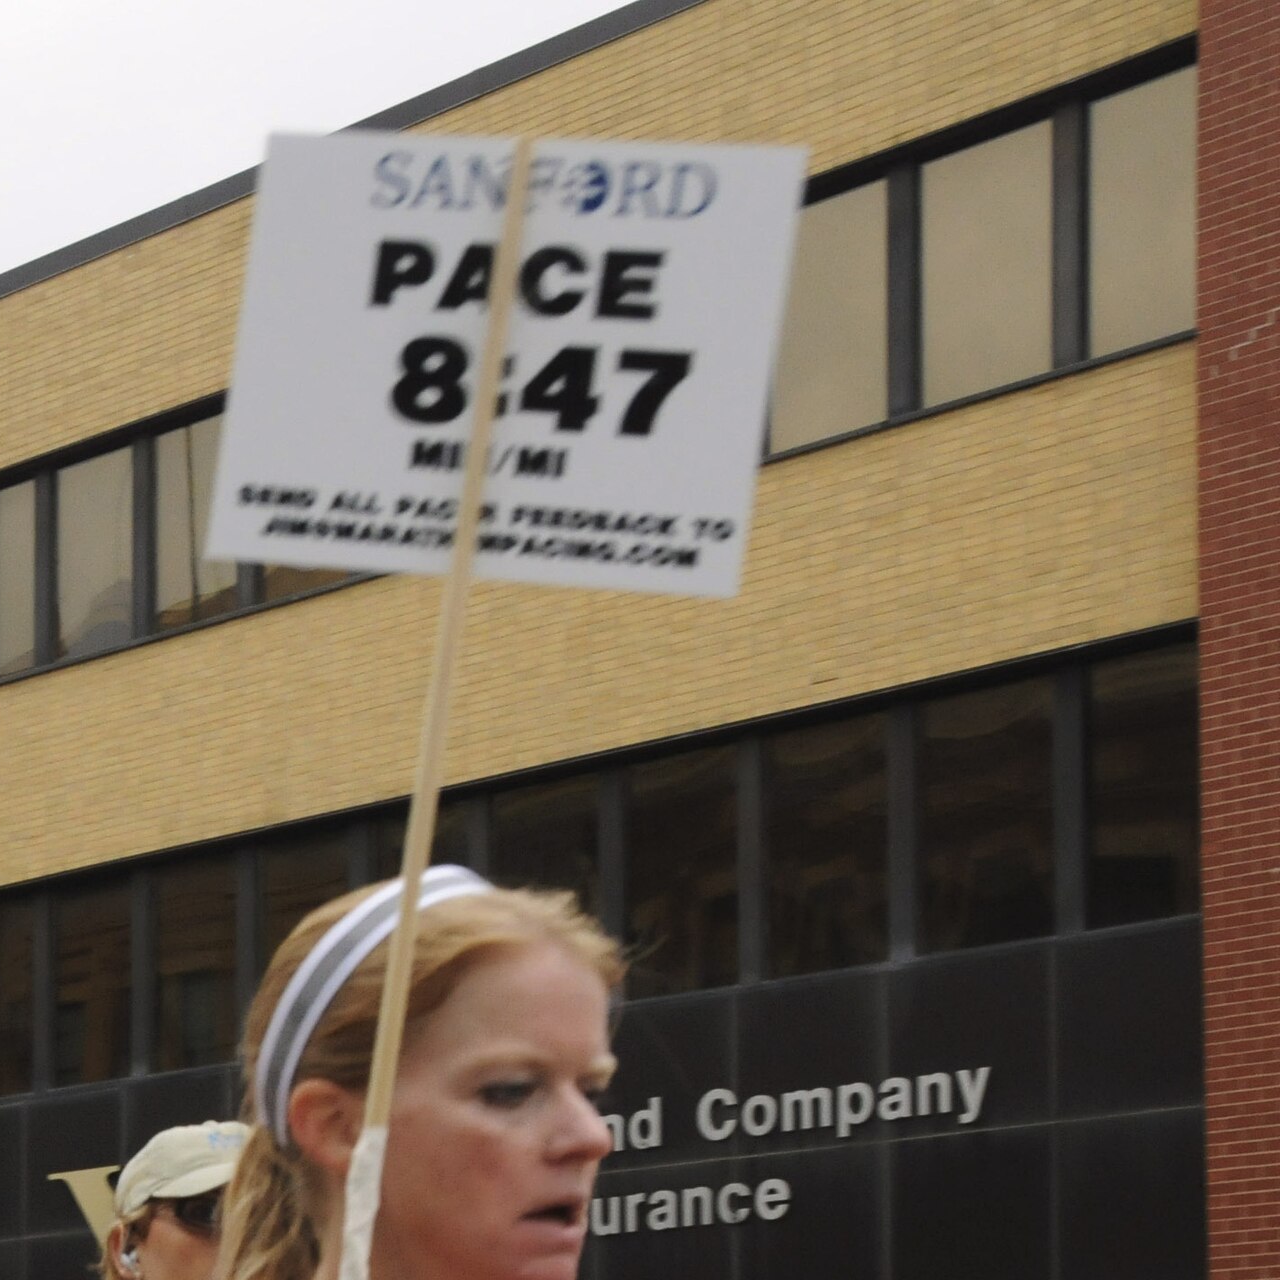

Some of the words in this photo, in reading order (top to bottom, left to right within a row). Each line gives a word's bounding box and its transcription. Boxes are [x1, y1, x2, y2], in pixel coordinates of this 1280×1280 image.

[371, 150, 720, 218] SANFORD
[369, 240, 667, 319] PACE
[391, 335, 695, 436] 8:47
[409, 440, 566, 478] MI/MI
[327, 489, 383, 515] ALL
[394, 495, 497, 525] PACR
[510, 504, 679, 537] FEEDBACK
[692, 519, 734, 543] TO
[696, 1066, 992, 1140] Company
[589, 1177, 792, 1237] urance
